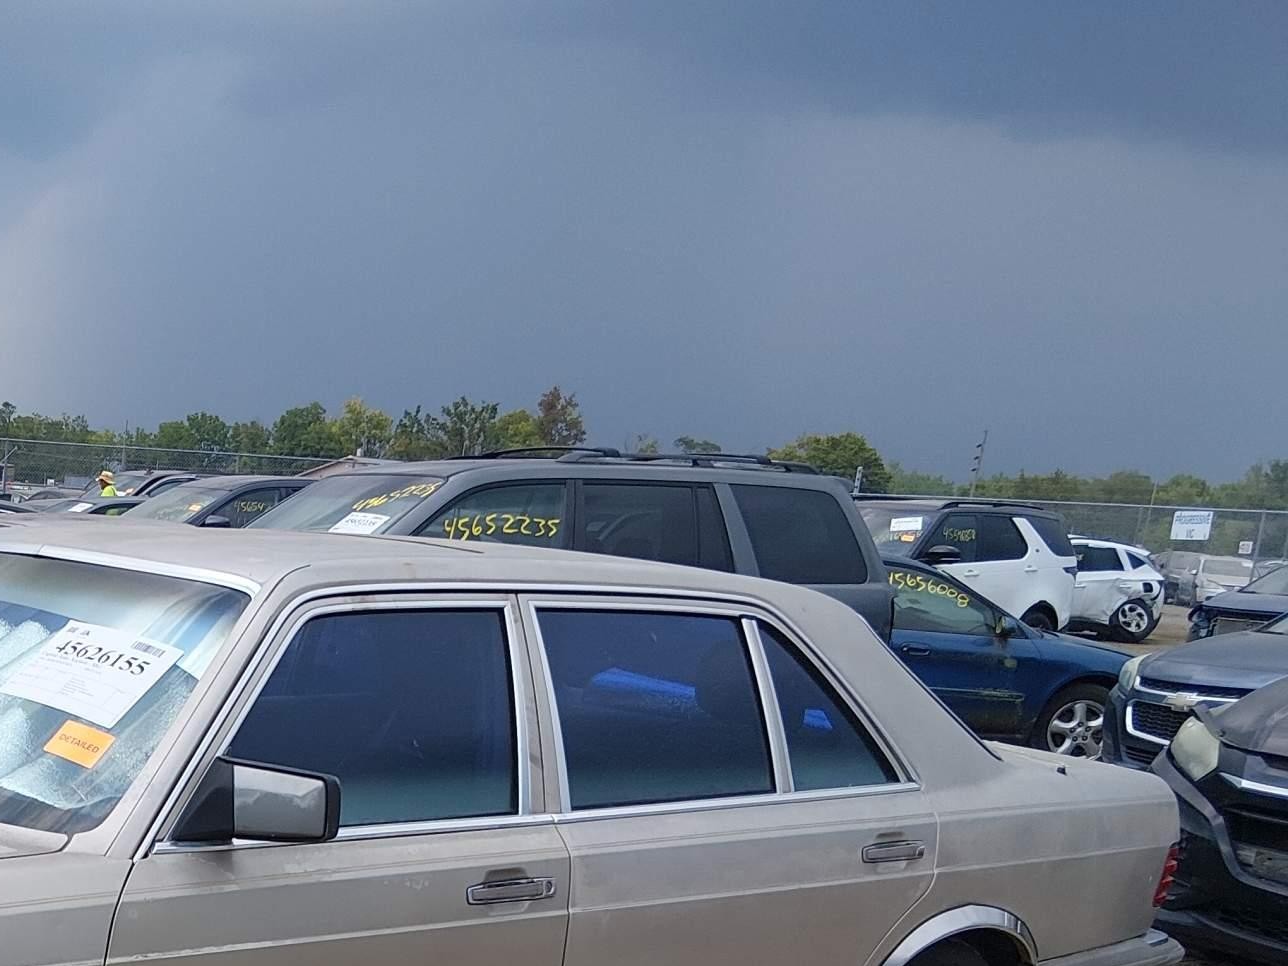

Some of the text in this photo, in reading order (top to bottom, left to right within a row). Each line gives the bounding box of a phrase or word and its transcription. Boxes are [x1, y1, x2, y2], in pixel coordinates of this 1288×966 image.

[233, 501, 273, 513] 45654
[444, 513, 561, 542] 45652235
[56, 640, 151, 676] 45626155
[59, 733, 100, 753] DETAILED
